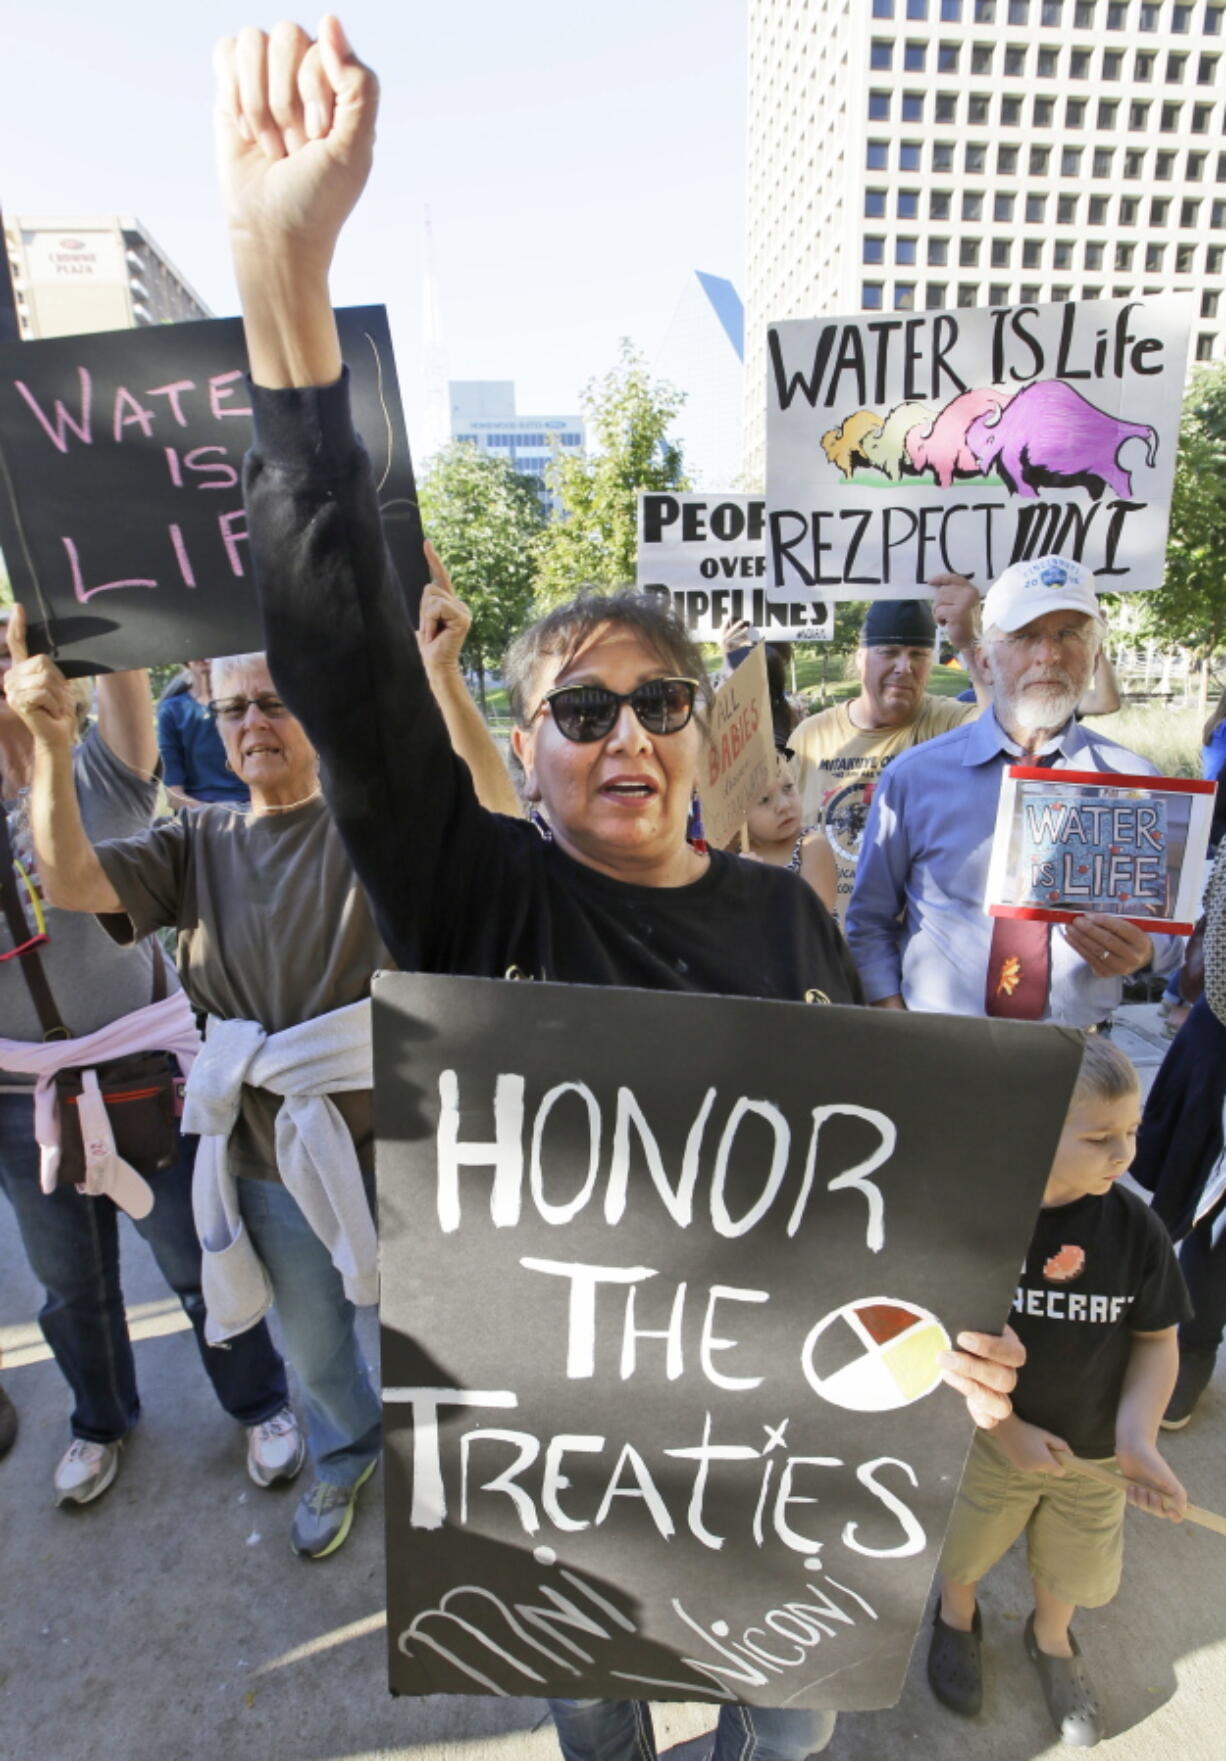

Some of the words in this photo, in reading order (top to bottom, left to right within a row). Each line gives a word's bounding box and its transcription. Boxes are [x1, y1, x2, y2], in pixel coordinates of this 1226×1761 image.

[767, 314, 968, 411] WATER
[990, 306, 1045, 386] IS
[1056, 302, 1165, 379] Life
[165, 446, 238, 489] IS
[769, 501, 1005, 588] REZPECT
[708, 698, 760, 787] BABIES
[1026, 804, 1164, 851] WATER
[1063, 852, 1161, 898] LIFE
[436, 1069, 898, 1254] HONOR
[519, 1257, 771, 1392] THE
